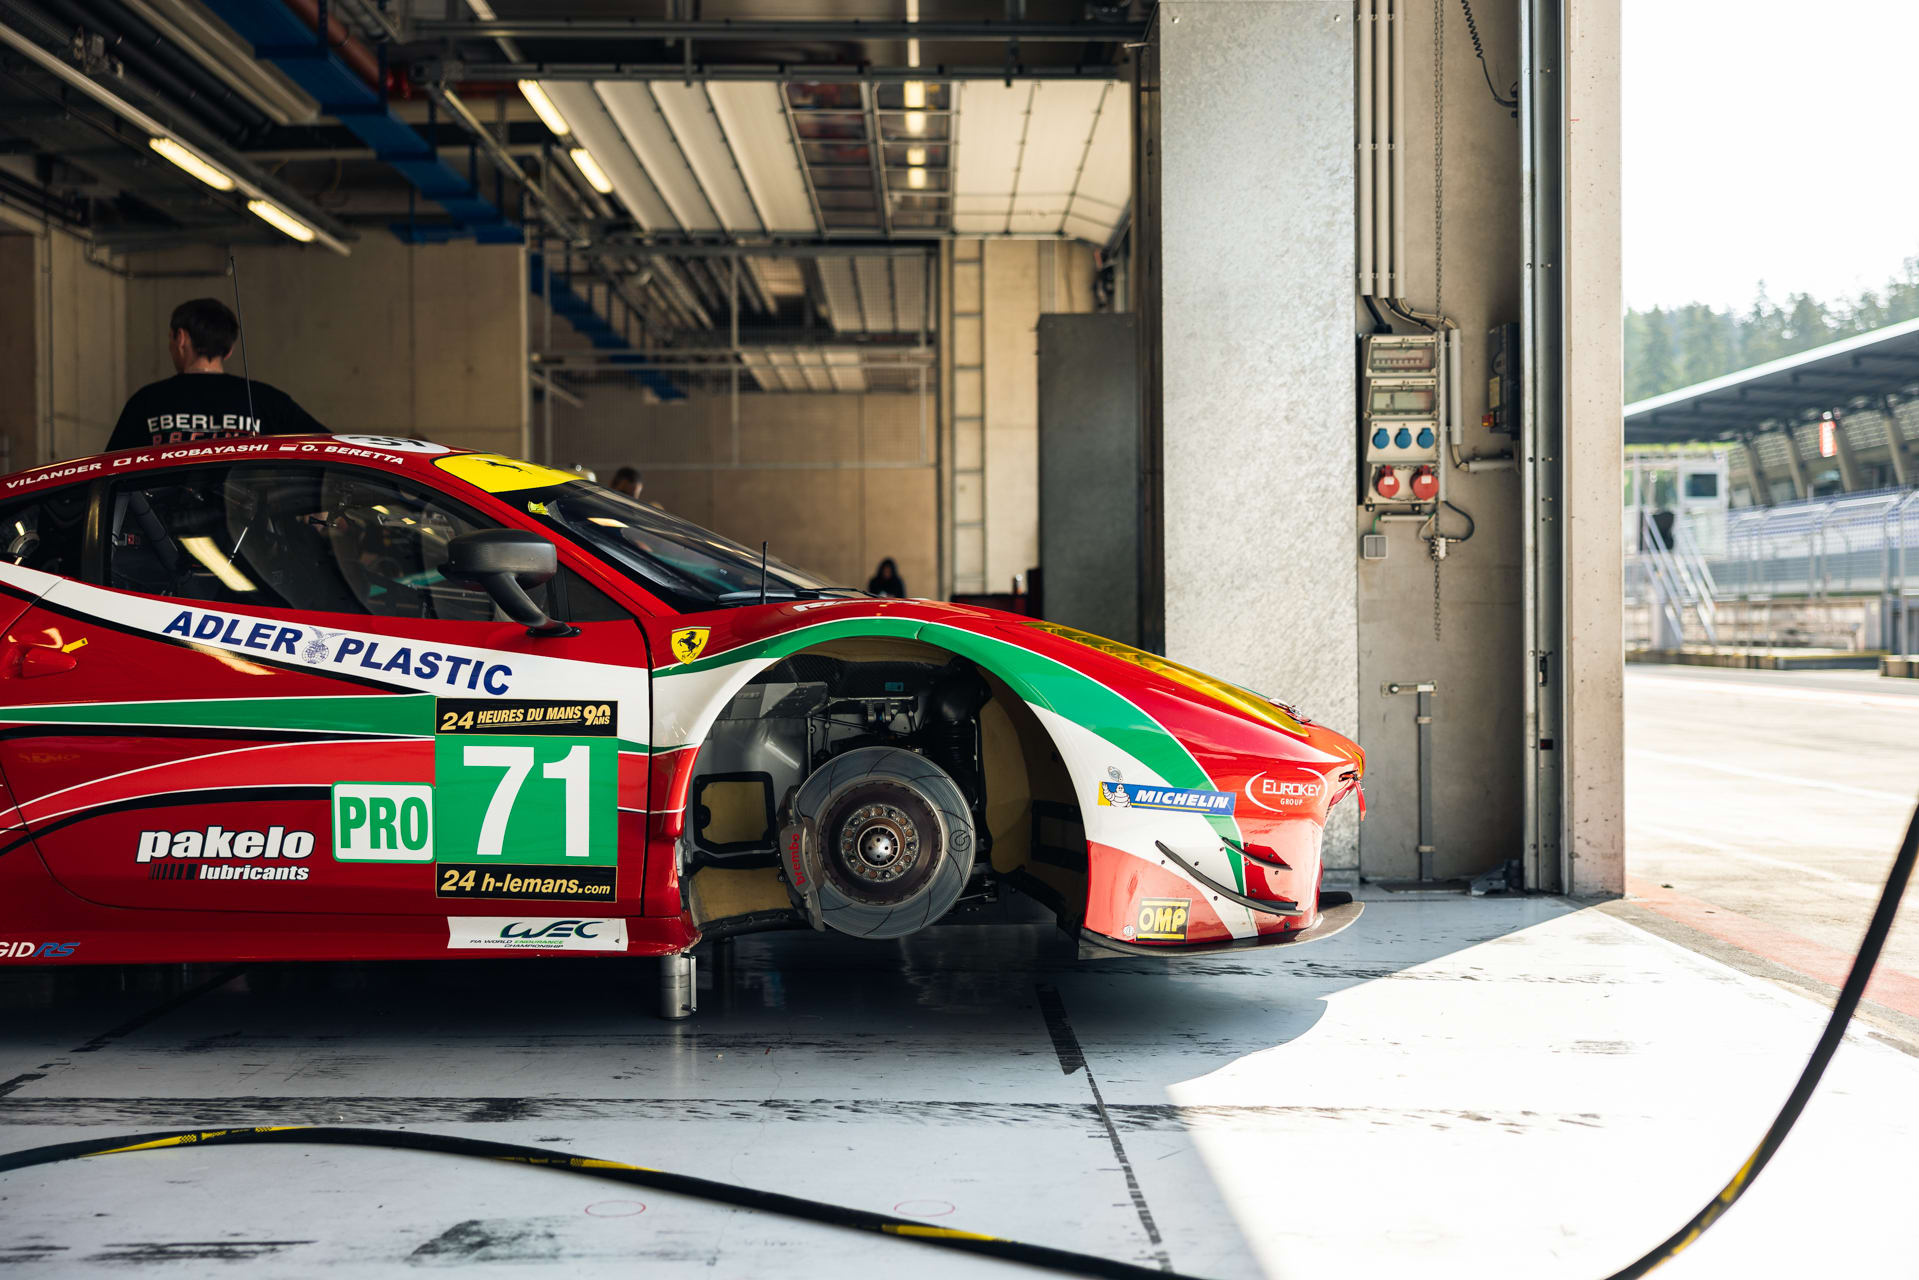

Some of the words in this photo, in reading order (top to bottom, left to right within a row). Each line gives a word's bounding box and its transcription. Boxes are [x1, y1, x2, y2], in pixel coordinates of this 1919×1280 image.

[147, 413, 261, 433] EBERLEIN
[135, 454, 155, 463] K.
[161, 444, 269, 460] KOBAYASHI
[301, 444, 318, 452] O.
[324, 445, 404, 465] BERETTA
[6, 463, 102, 488] VILANDER
[163, 611, 303, 656] ADLER
[334, 638, 513, 696] PLASTIC
[440, 711, 474, 731] 24
[477, 709, 524, 724] HEURES
[526, 708, 544, 721] DU
[546, 706, 582, 720] MANS
[593, 716, 610, 725] ANS
[1263, 779, 1321, 796] EUROKEY
[463, 745, 590, 857] 71
[1135, 790, 1229, 809] MICHELIN
[339, 796, 429, 851] PRO
[136, 826, 315, 863] pakelo
[788, 833, 806, 886] brembo
[199, 864, 310, 881] lubricants
[440, 870, 475, 891] 24
[500, 920, 604, 939] WEC
[1138, 907, 1187, 932] OMP
